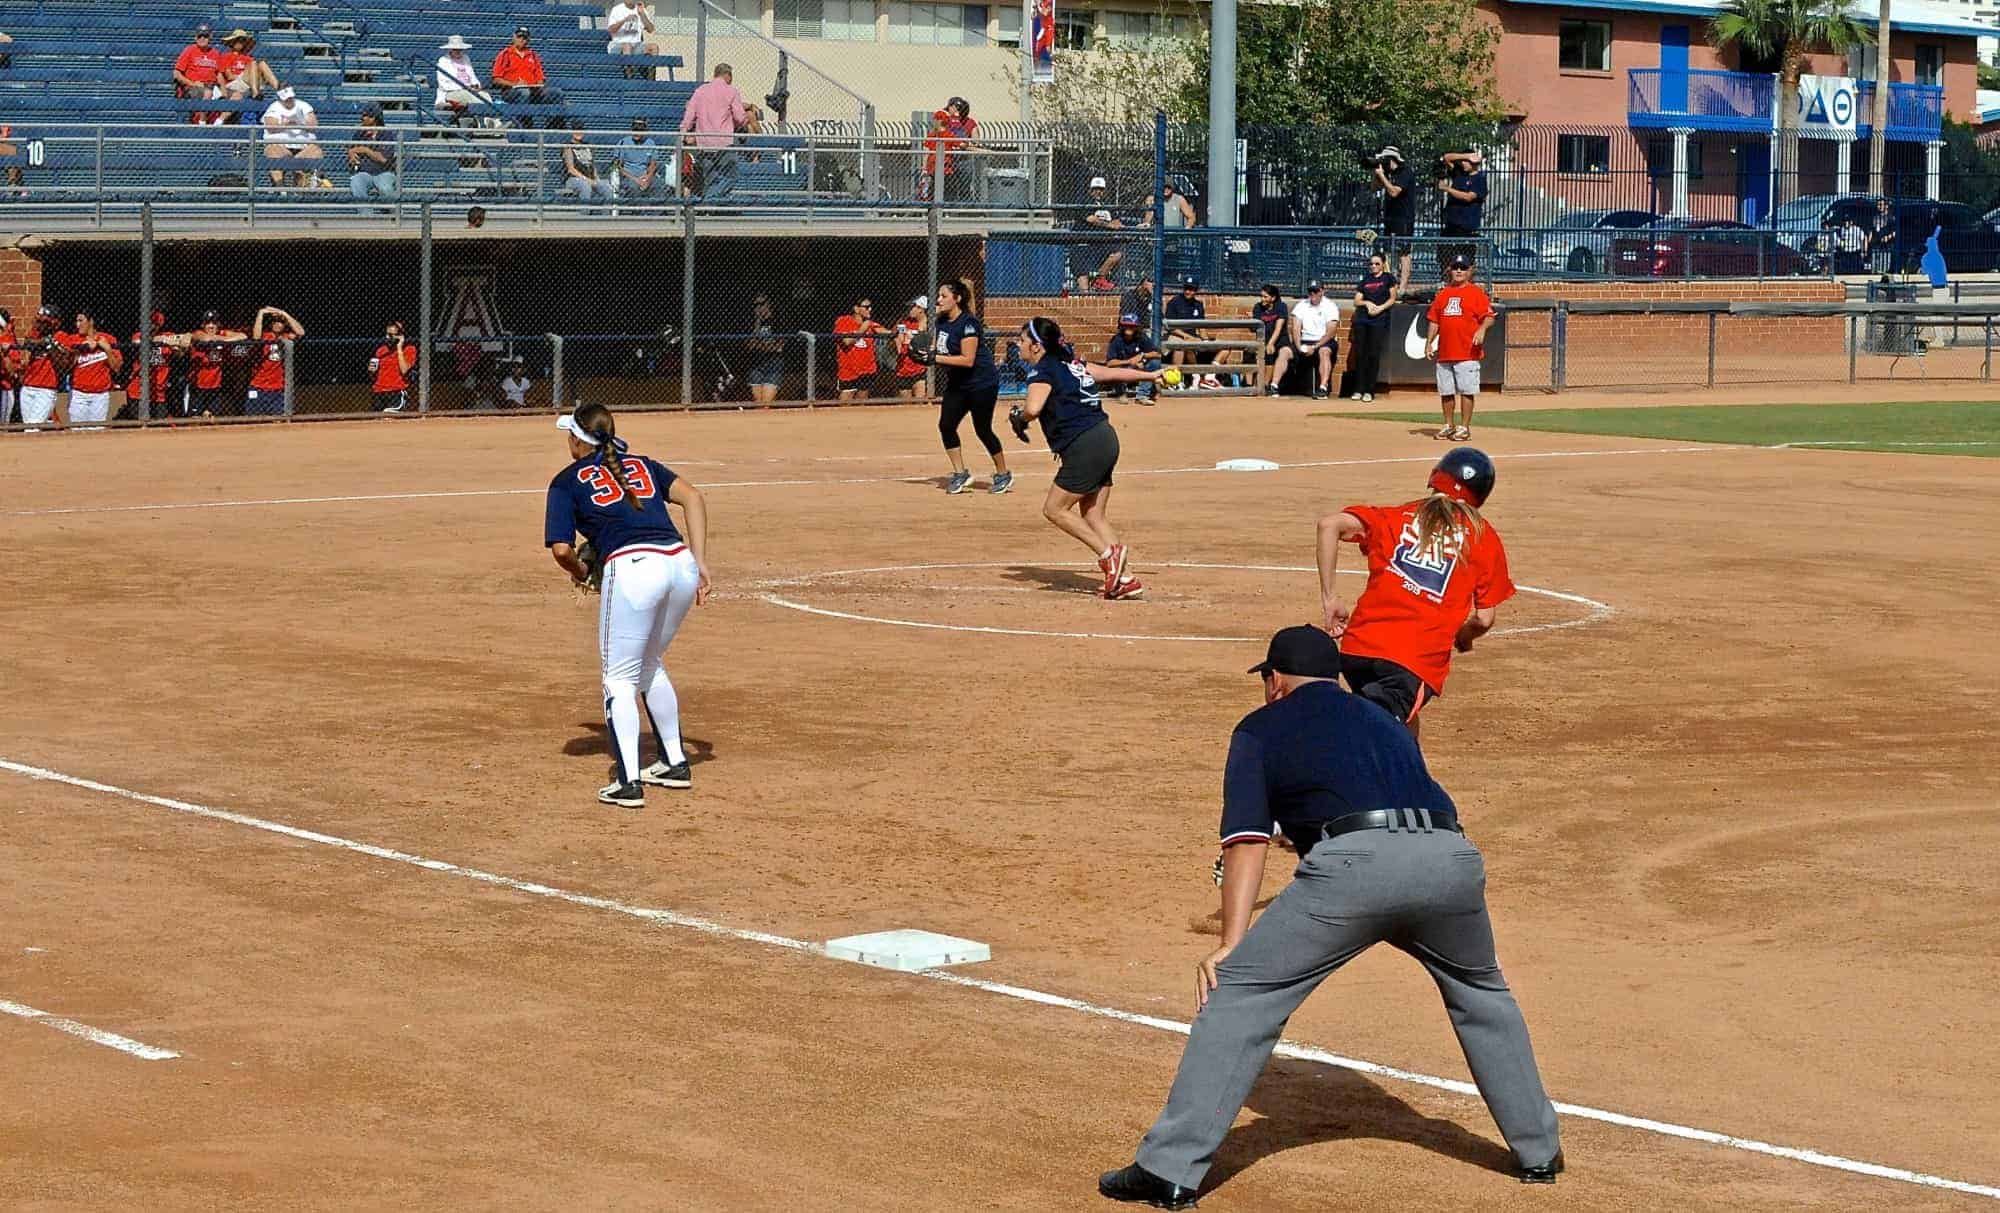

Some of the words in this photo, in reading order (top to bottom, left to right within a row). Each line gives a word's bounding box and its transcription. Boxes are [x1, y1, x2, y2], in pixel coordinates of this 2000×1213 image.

[1797, 88, 1852, 125] ΔΘ
[27, 141, 43, 165] 10
[781, 152, 796, 174] 11
[1443, 297, 1463, 316] A
[577, 458, 657, 506] 33
